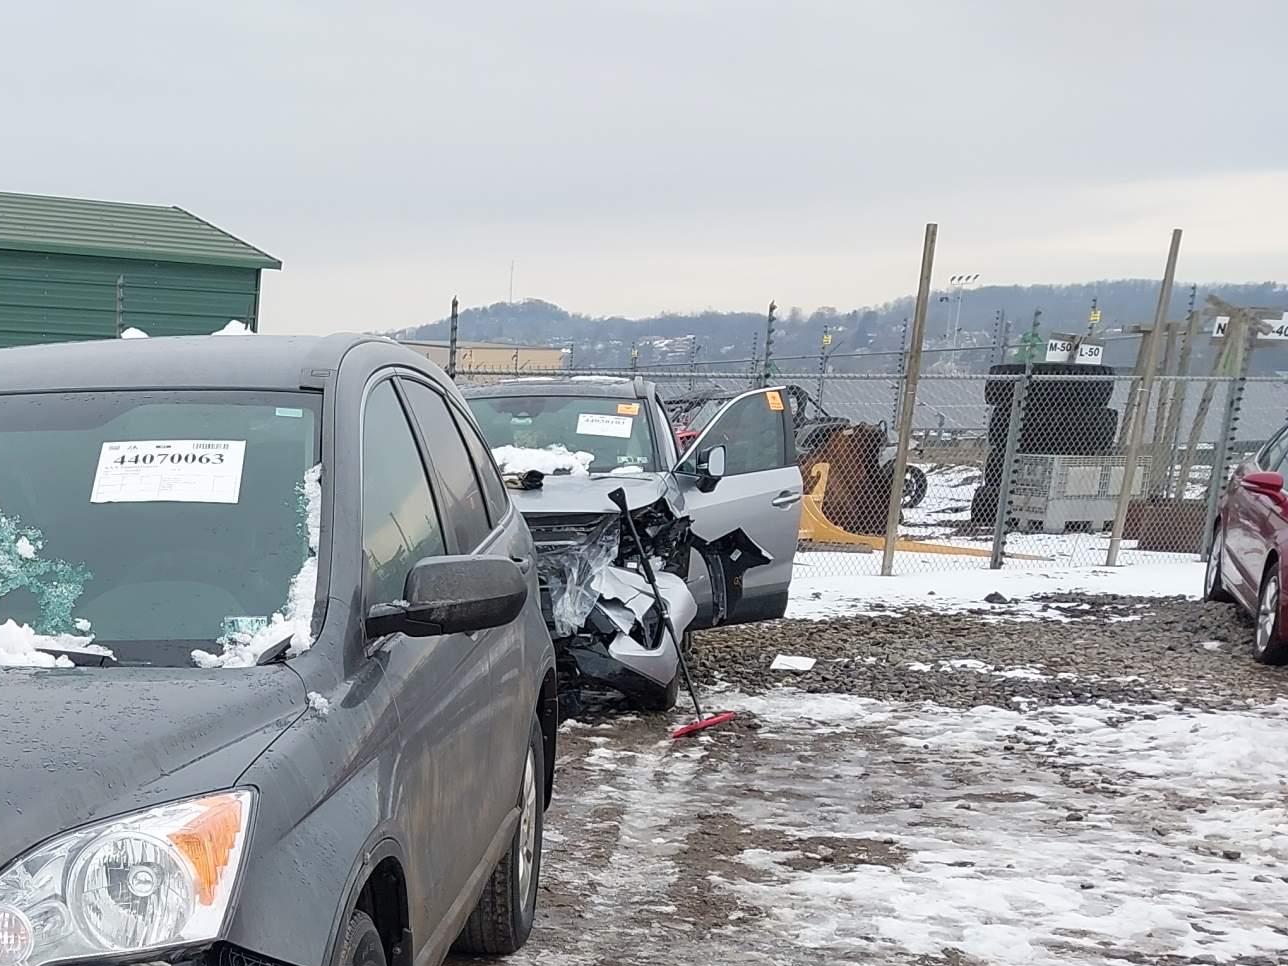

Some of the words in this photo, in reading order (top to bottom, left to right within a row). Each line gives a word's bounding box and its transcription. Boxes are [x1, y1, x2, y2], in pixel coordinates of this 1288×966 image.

[1048, 342, 1072, 352] M-50
[1079, 347, 1100, 357] L-50
[113, 452, 225, 466] 44070063
